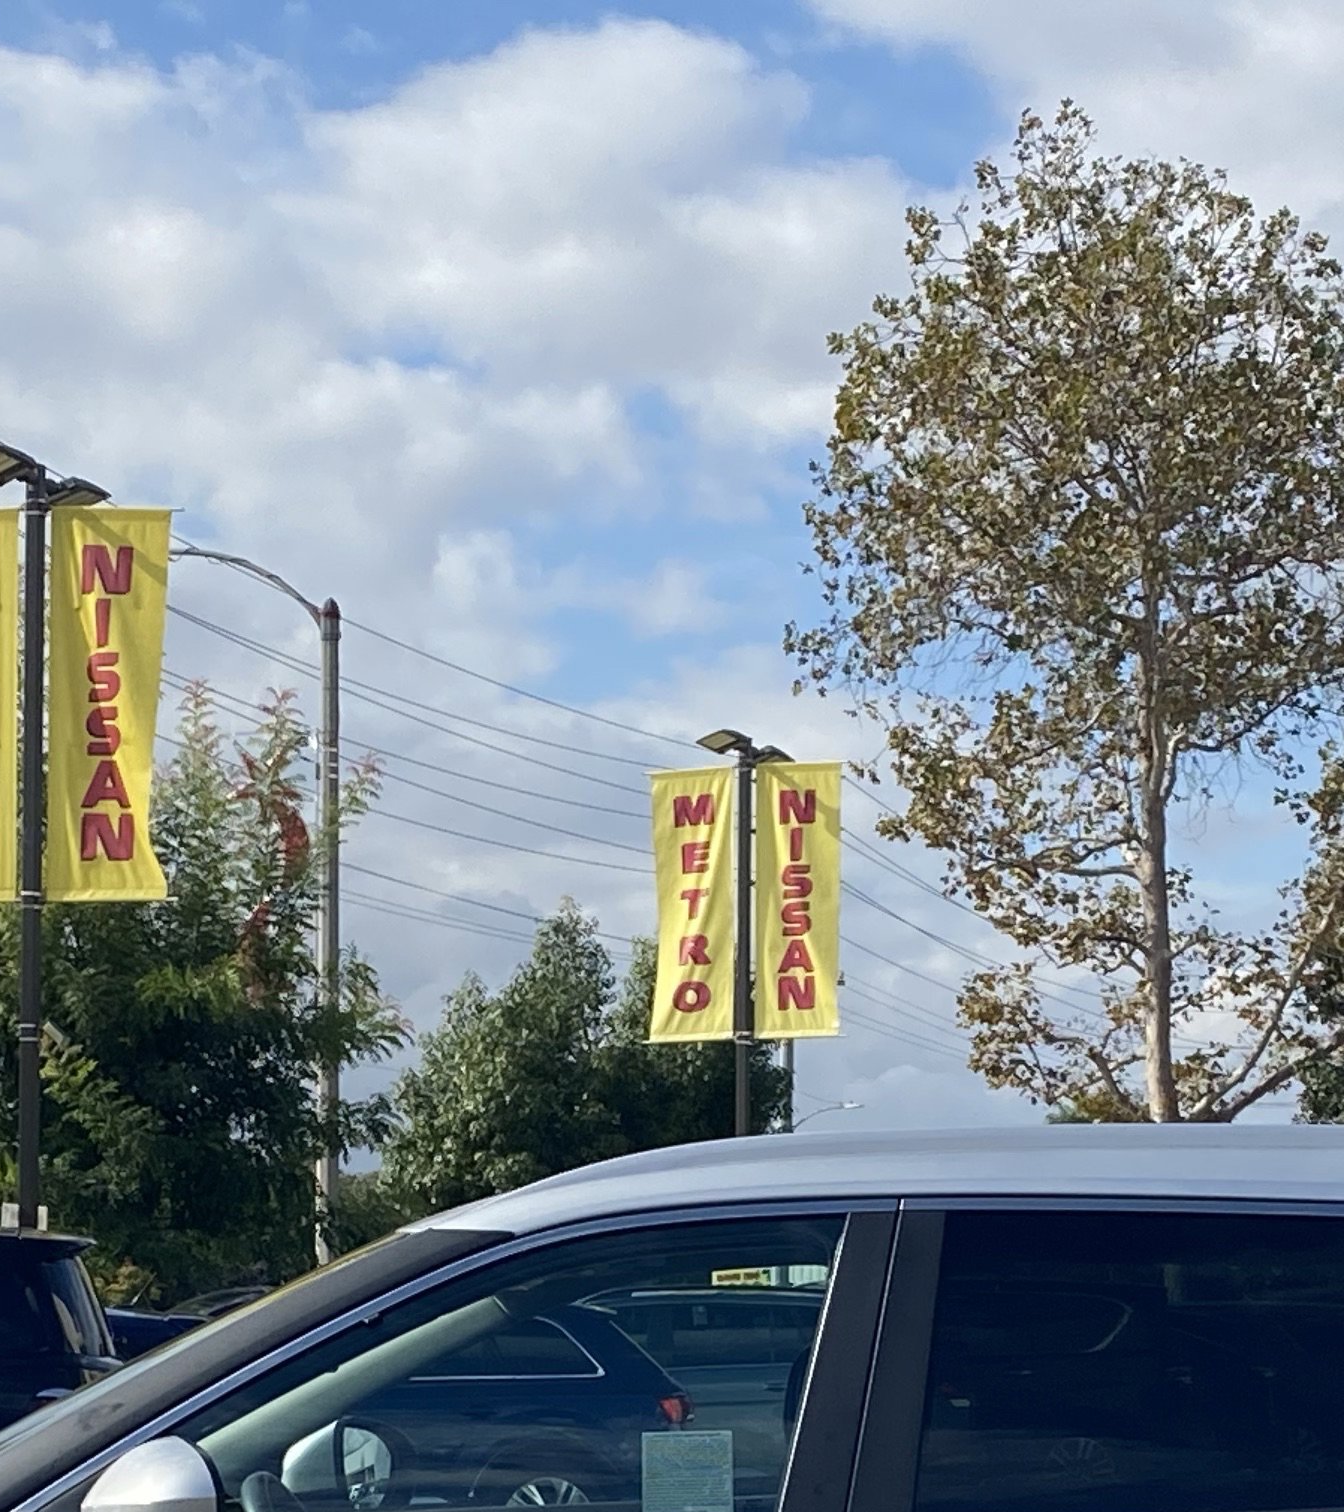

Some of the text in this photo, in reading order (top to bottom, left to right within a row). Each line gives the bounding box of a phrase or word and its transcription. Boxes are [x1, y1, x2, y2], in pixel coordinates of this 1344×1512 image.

[80, 544, 136, 863] NISSAN
[672, 793, 716, 1014] METRO
[777, 789, 817, 1011] NISSAN
